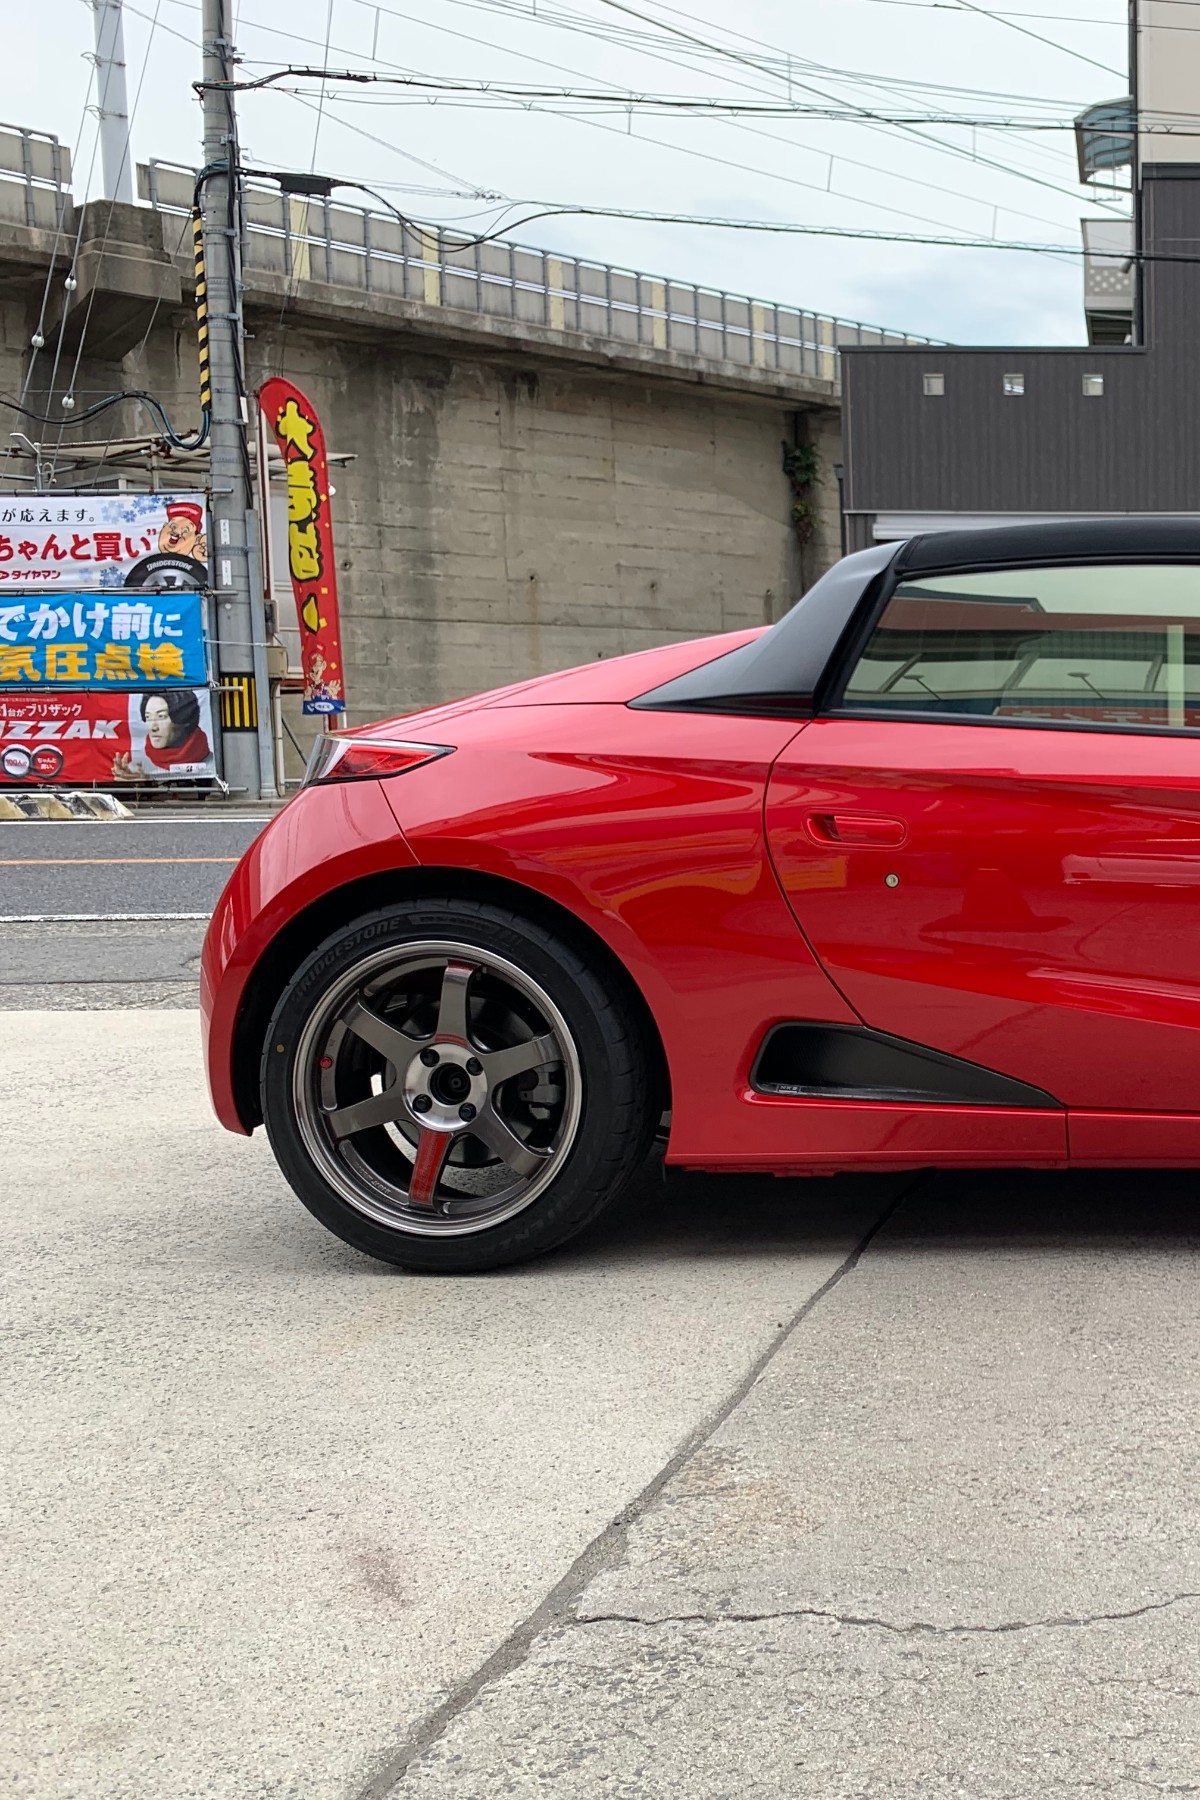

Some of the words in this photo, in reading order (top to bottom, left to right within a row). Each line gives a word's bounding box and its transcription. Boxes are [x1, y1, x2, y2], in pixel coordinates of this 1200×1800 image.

[2, 508, 95, 523] が応えます。
[12, 570, 61, 580] タイヤマン
[0, 602, 183, 641] でかけ前に
[0, 703, 82, 717] 1台がブリザック
